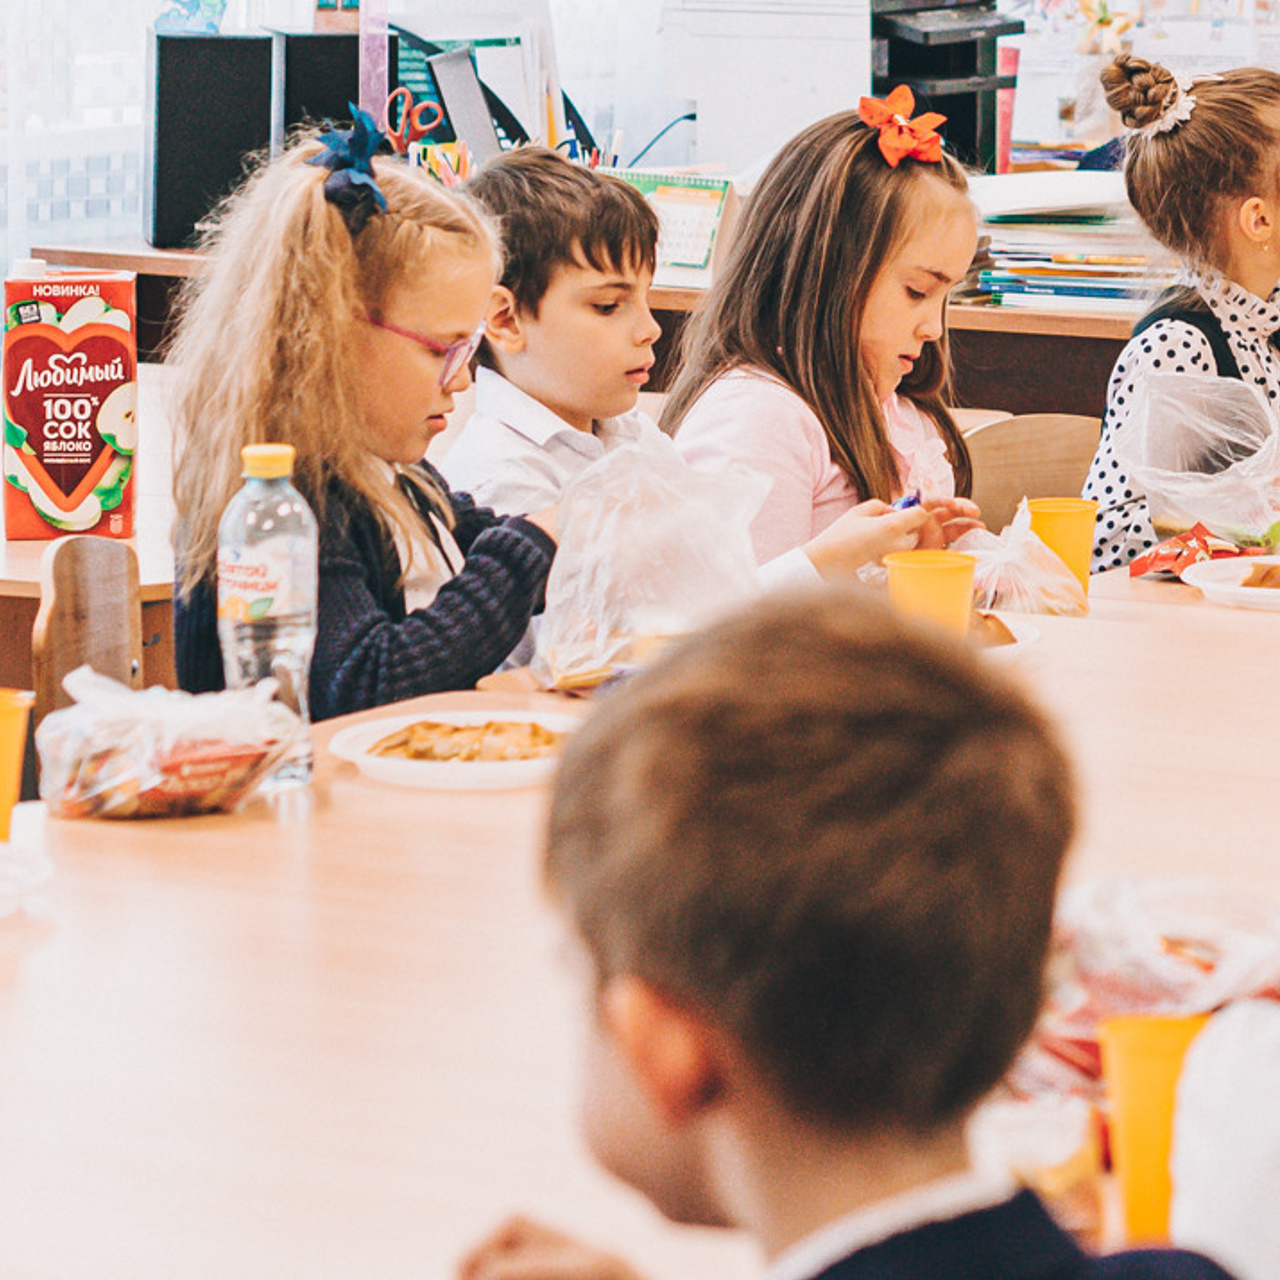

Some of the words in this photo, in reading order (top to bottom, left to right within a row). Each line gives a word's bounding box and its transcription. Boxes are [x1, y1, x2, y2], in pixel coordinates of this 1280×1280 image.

[32, 284, 100, 297] НОВИНКА!
[11, 353, 125, 397] Любимый
[43, 422, 91, 439] СОК
[43, 441, 92, 452] ЯБЛОКО
